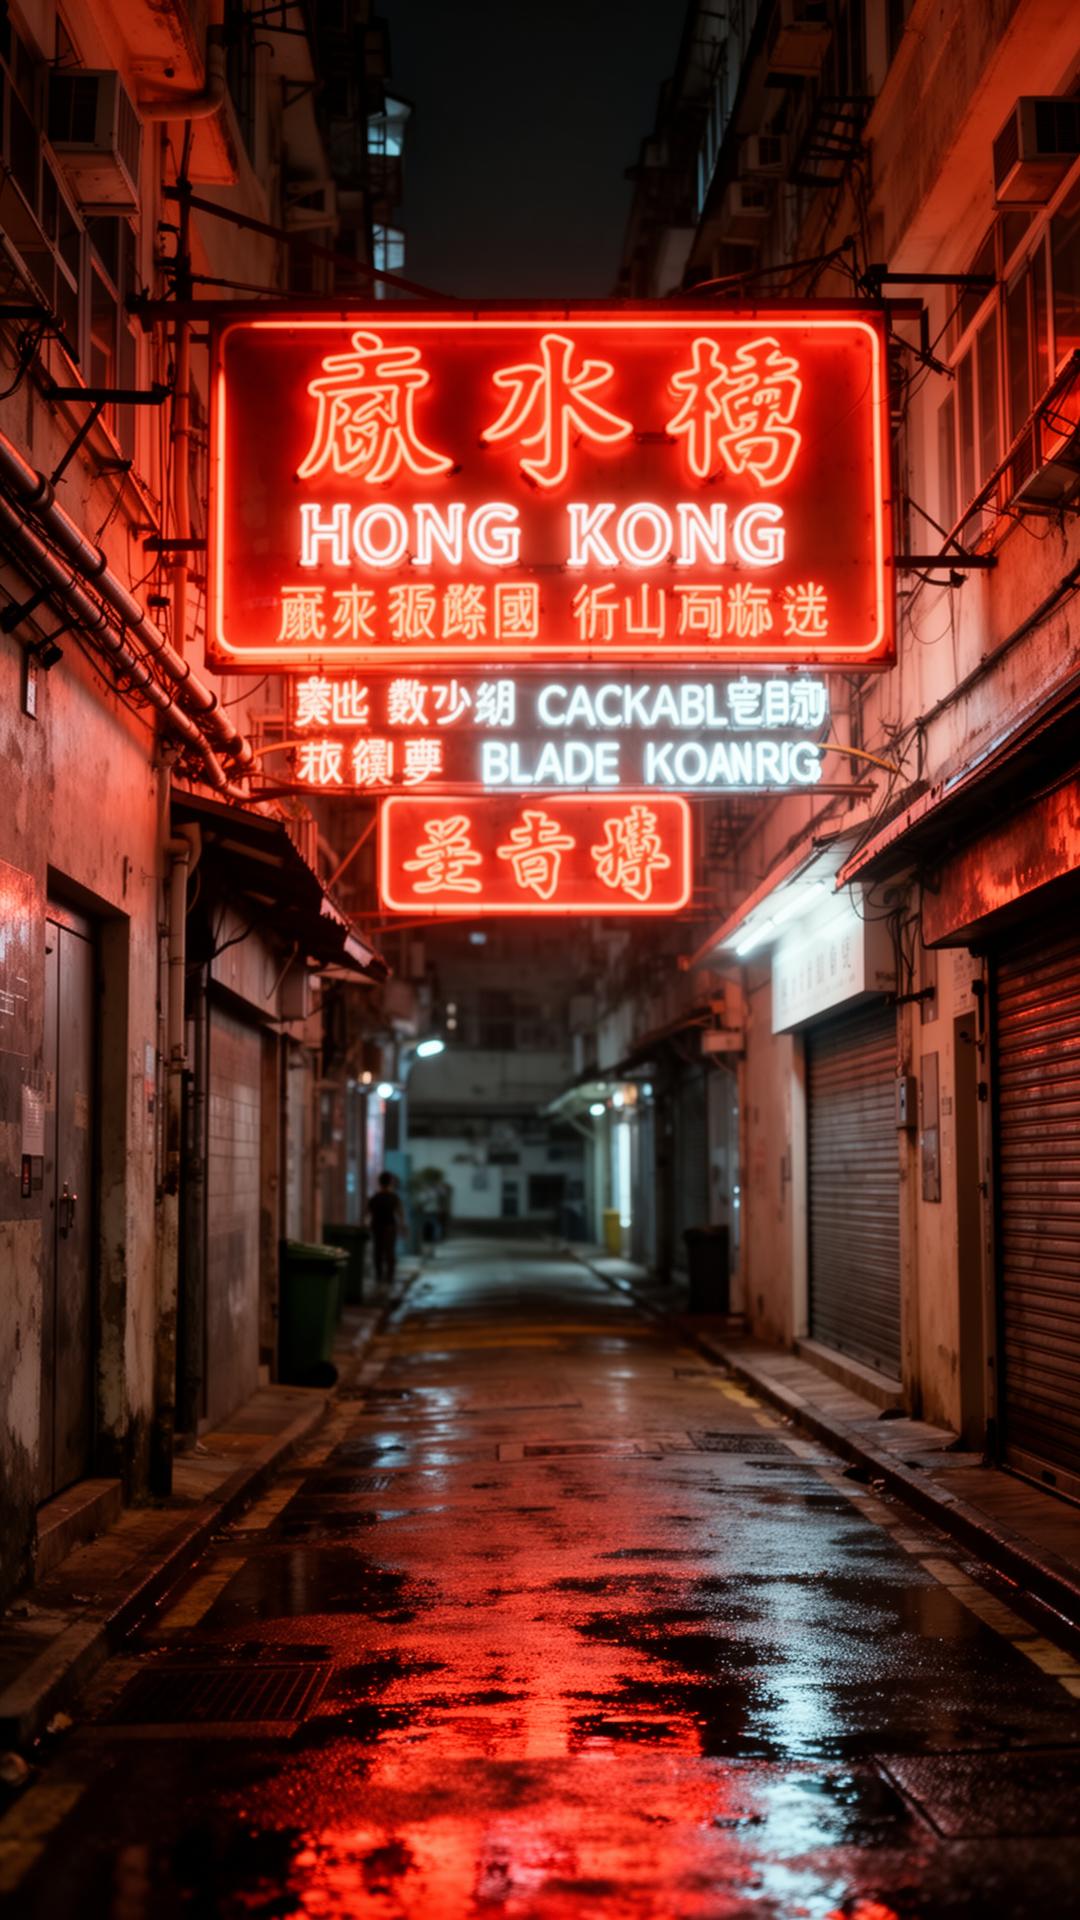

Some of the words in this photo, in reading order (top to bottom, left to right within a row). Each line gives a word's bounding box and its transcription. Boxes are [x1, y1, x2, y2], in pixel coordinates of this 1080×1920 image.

[299, 502, 521, 567] HONG
[566, 502, 785, 567] KONG
[481, 741, 621, 785] BLADE
